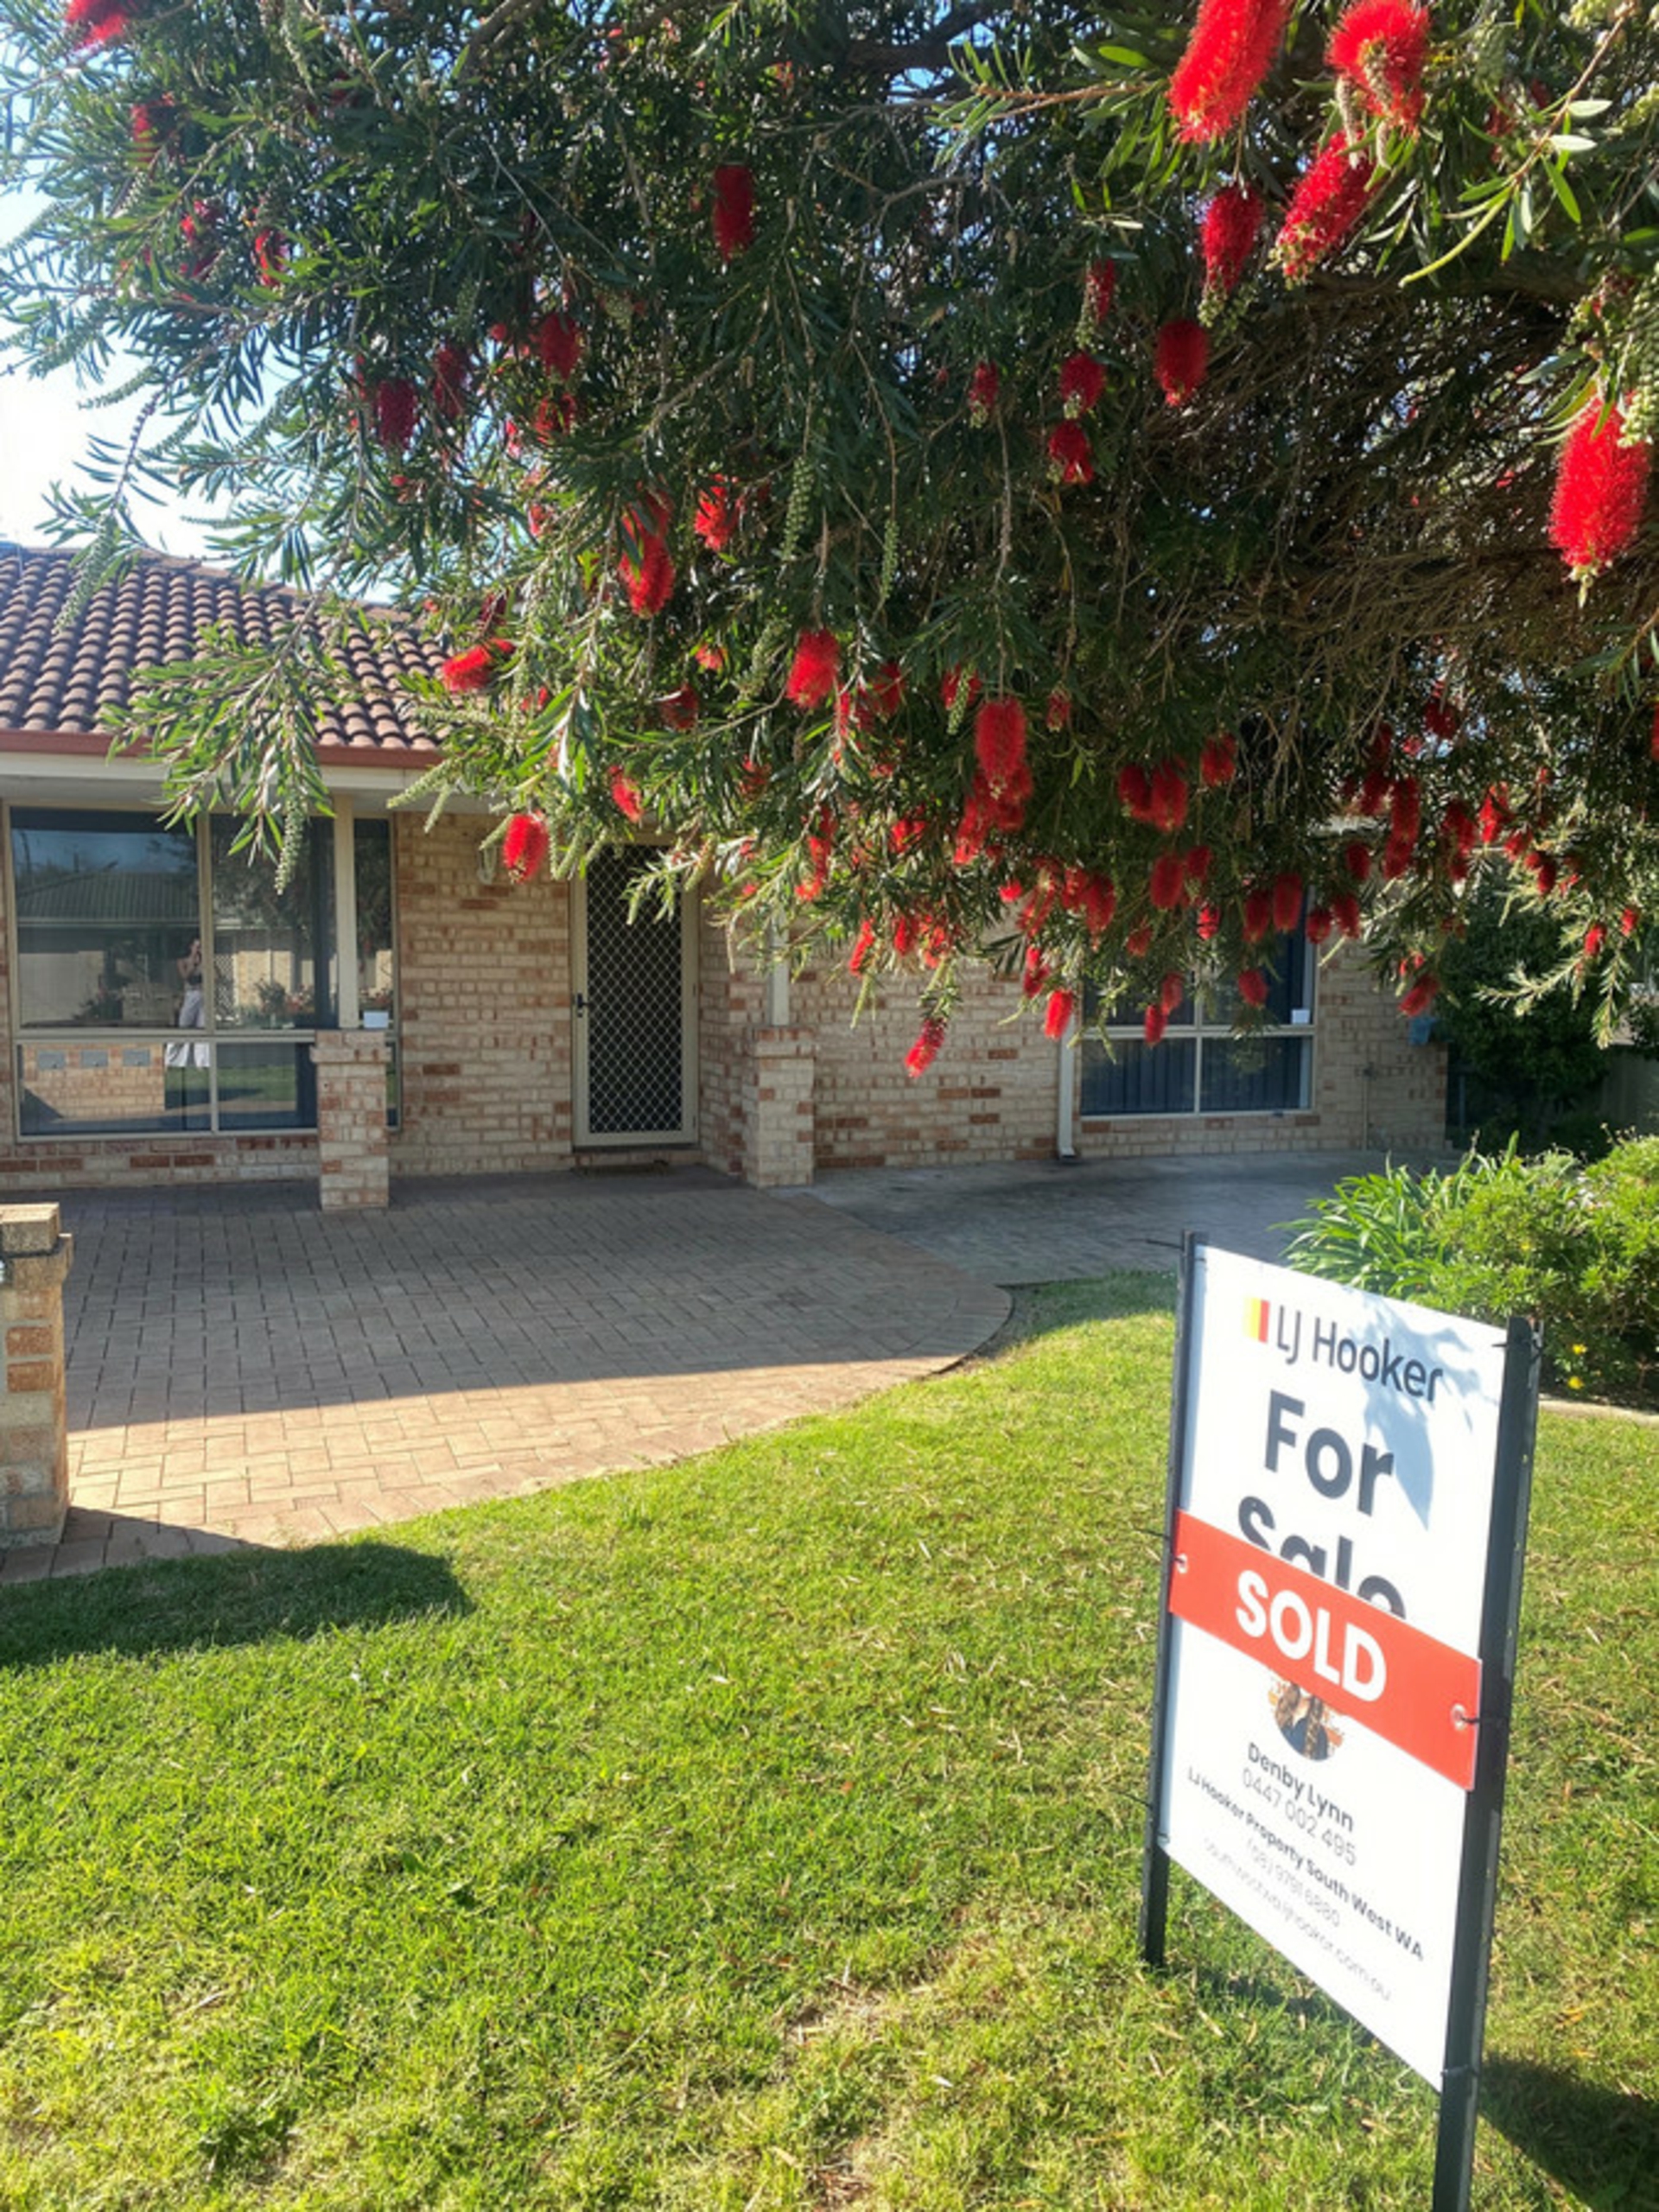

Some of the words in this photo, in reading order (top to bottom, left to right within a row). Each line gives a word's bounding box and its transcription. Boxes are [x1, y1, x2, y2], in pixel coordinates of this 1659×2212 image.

[1276, 1305, 1301, 1365] LJ
[1313, 1317, 1443, 1402] Hooker
[1265, 1389, 1395, 1517] For
[1235, 1569, 1387, 1702] SOLD
[1243, 1767, 1282, 1808] 0447
[1285, 1798, 1319, 1839] 002
[1320, 1827, 1357, 1866] 495
[1248, 1740, 1306, 1801] Denby
[1306, 1783, 1354, 1832] Lynn
[1200, 1777, 1245, 1820] Hooker
[1245, 1811, 1306, 1872] Property
[1306, 1858, 1351, 1904] South
[1351, 1892, 1393, 1938] West
[1395, 1926, 1424, 1962] WA
